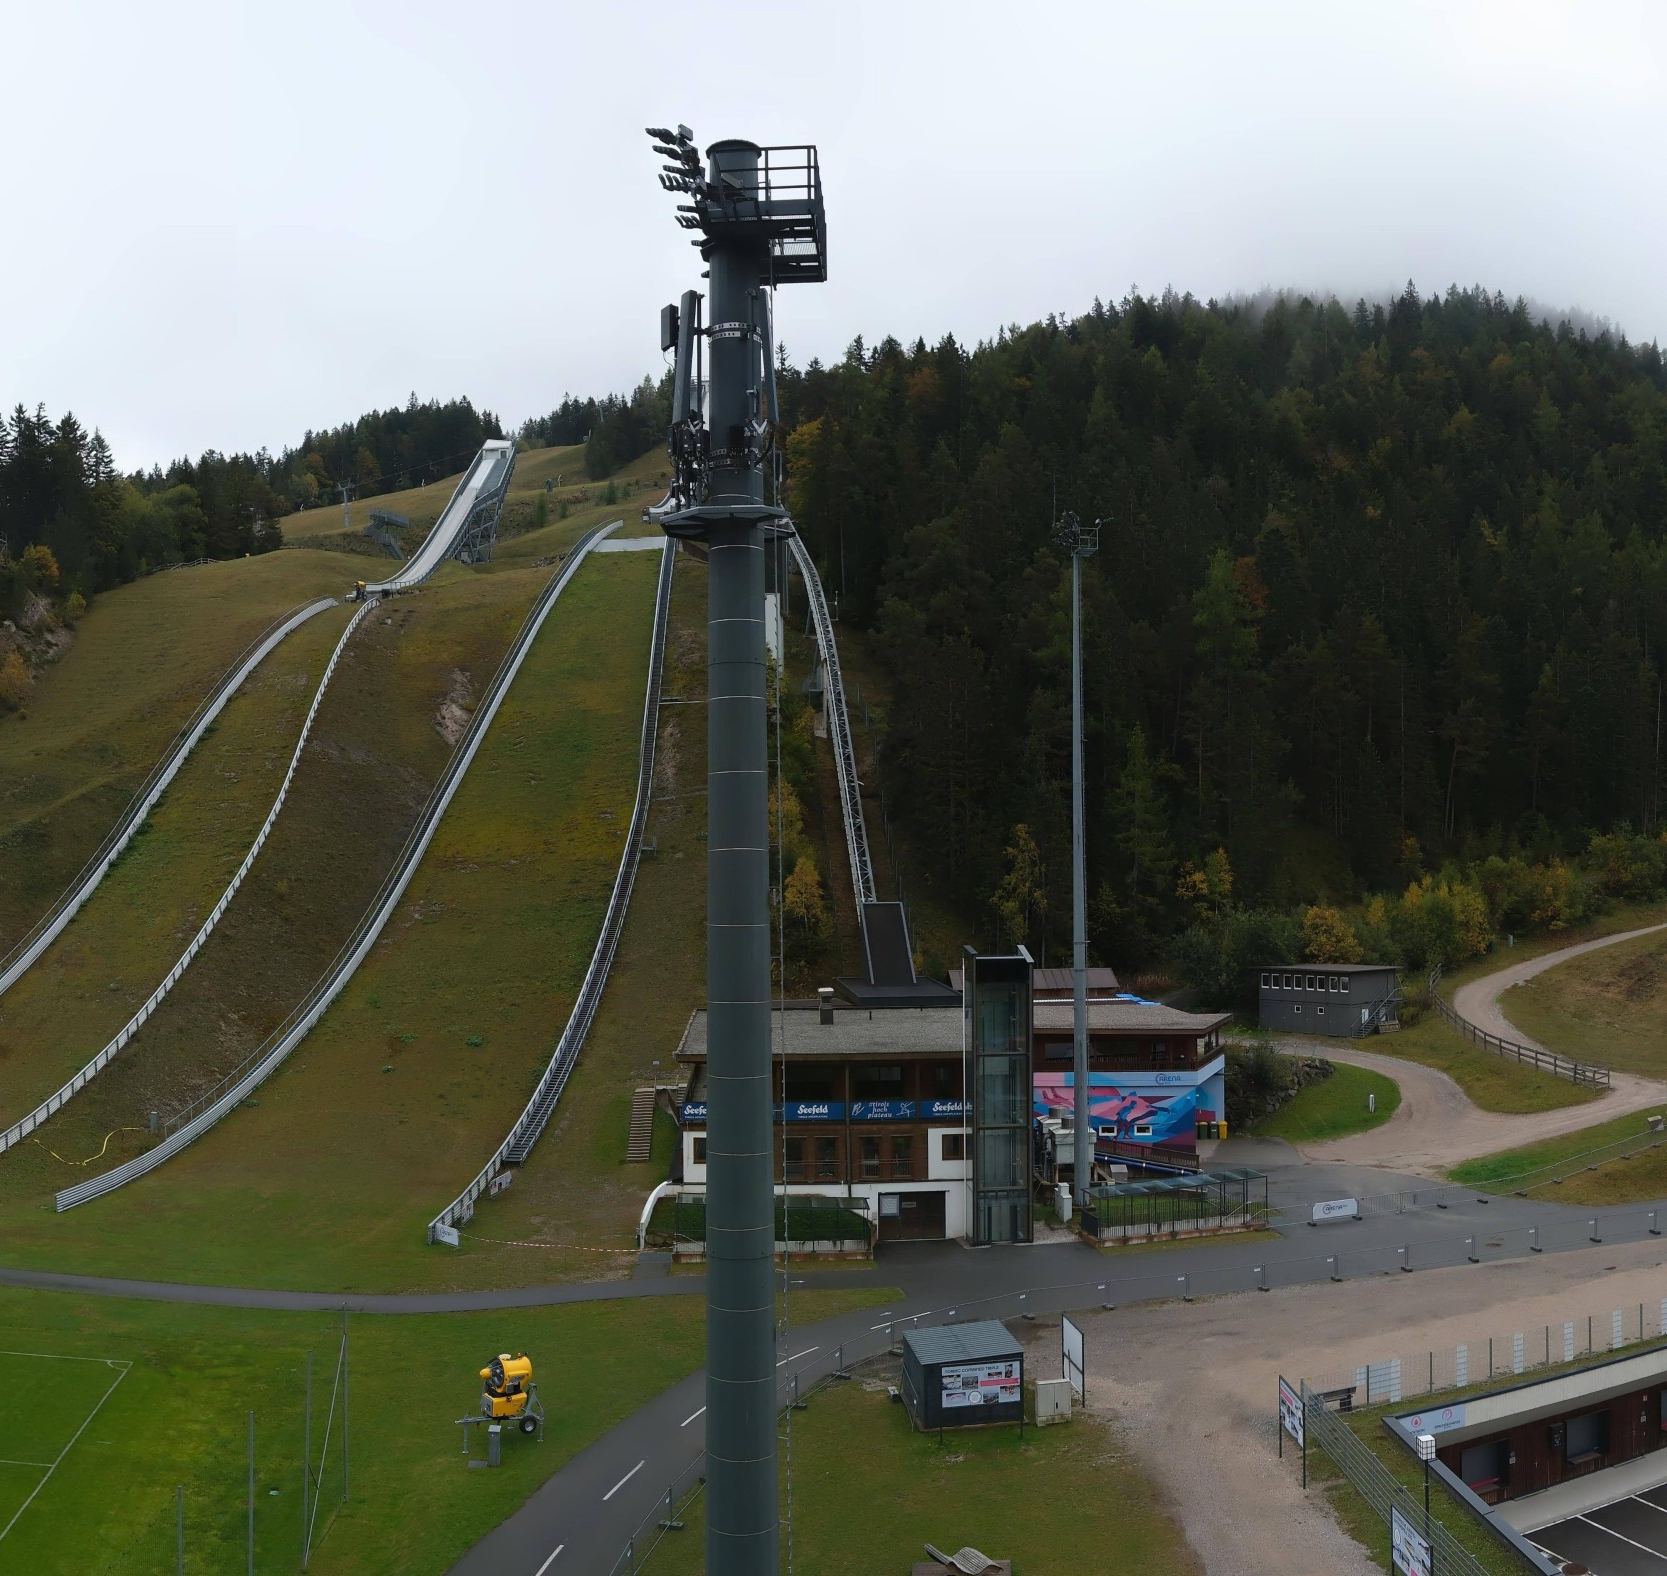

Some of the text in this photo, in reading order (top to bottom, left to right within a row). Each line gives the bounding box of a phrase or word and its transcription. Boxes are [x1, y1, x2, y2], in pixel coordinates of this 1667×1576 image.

[684, 1104, 707, 1115] Seefe
[797, 1104, 829, 1115] Seefeld
[932, 1101, 963, 1112] Seefeld
